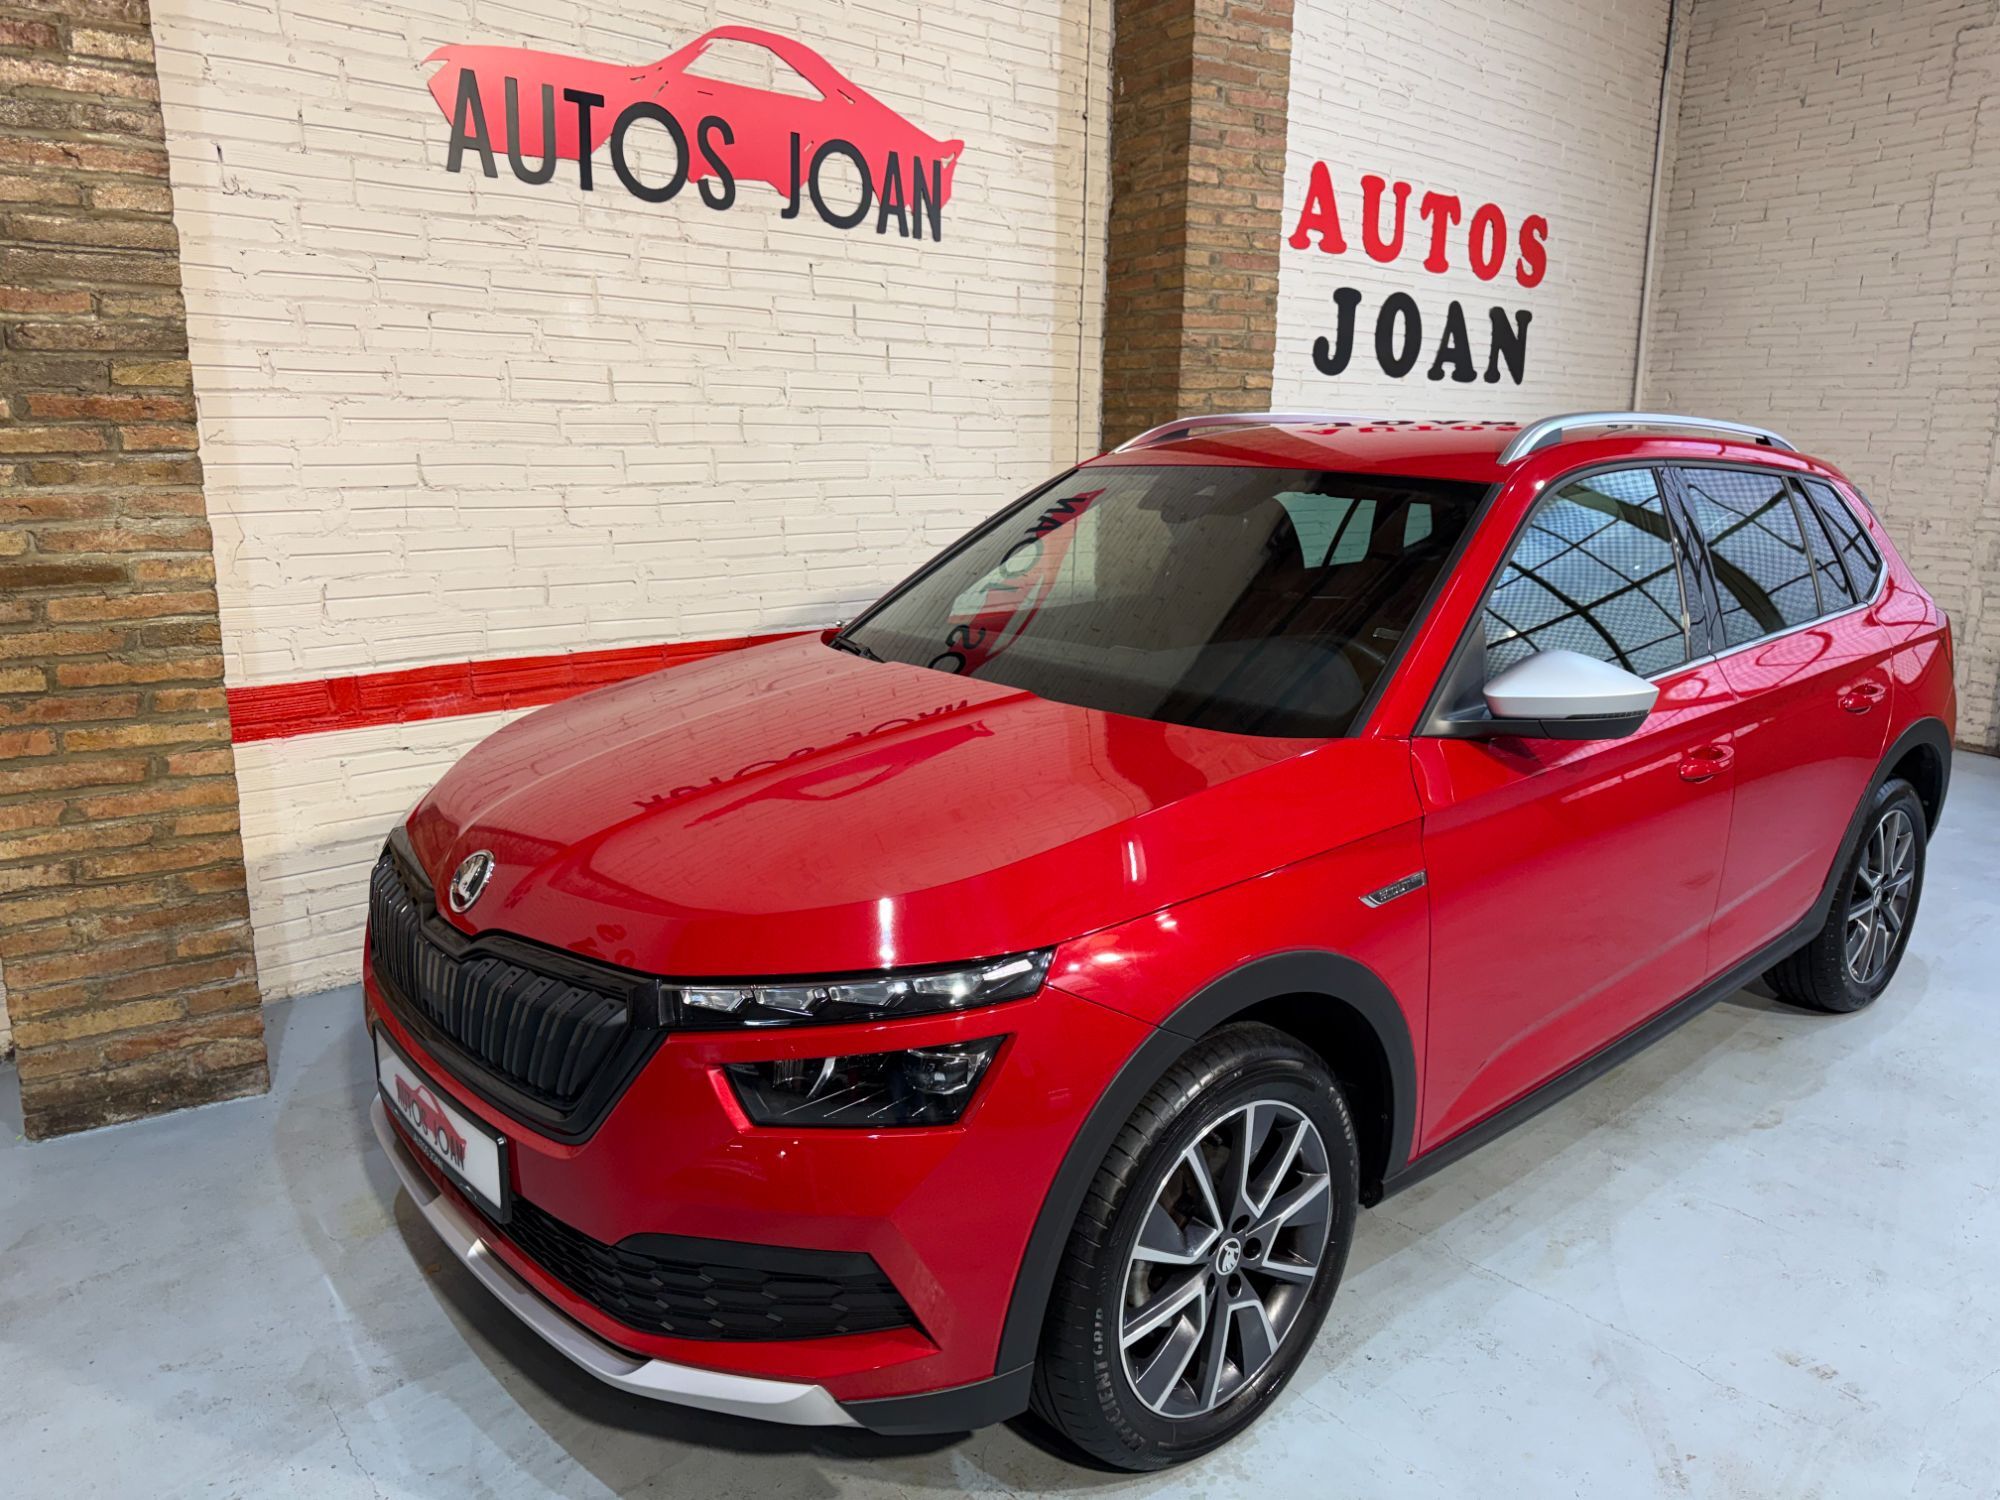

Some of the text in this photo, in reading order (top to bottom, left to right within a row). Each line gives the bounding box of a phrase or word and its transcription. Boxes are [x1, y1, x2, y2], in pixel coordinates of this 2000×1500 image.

[446, 68, 942, 242] AUTOS JOAN
[1288, 161, 1548, 288] AUTOS
[1312, 287, 1533, 385] JOAN
